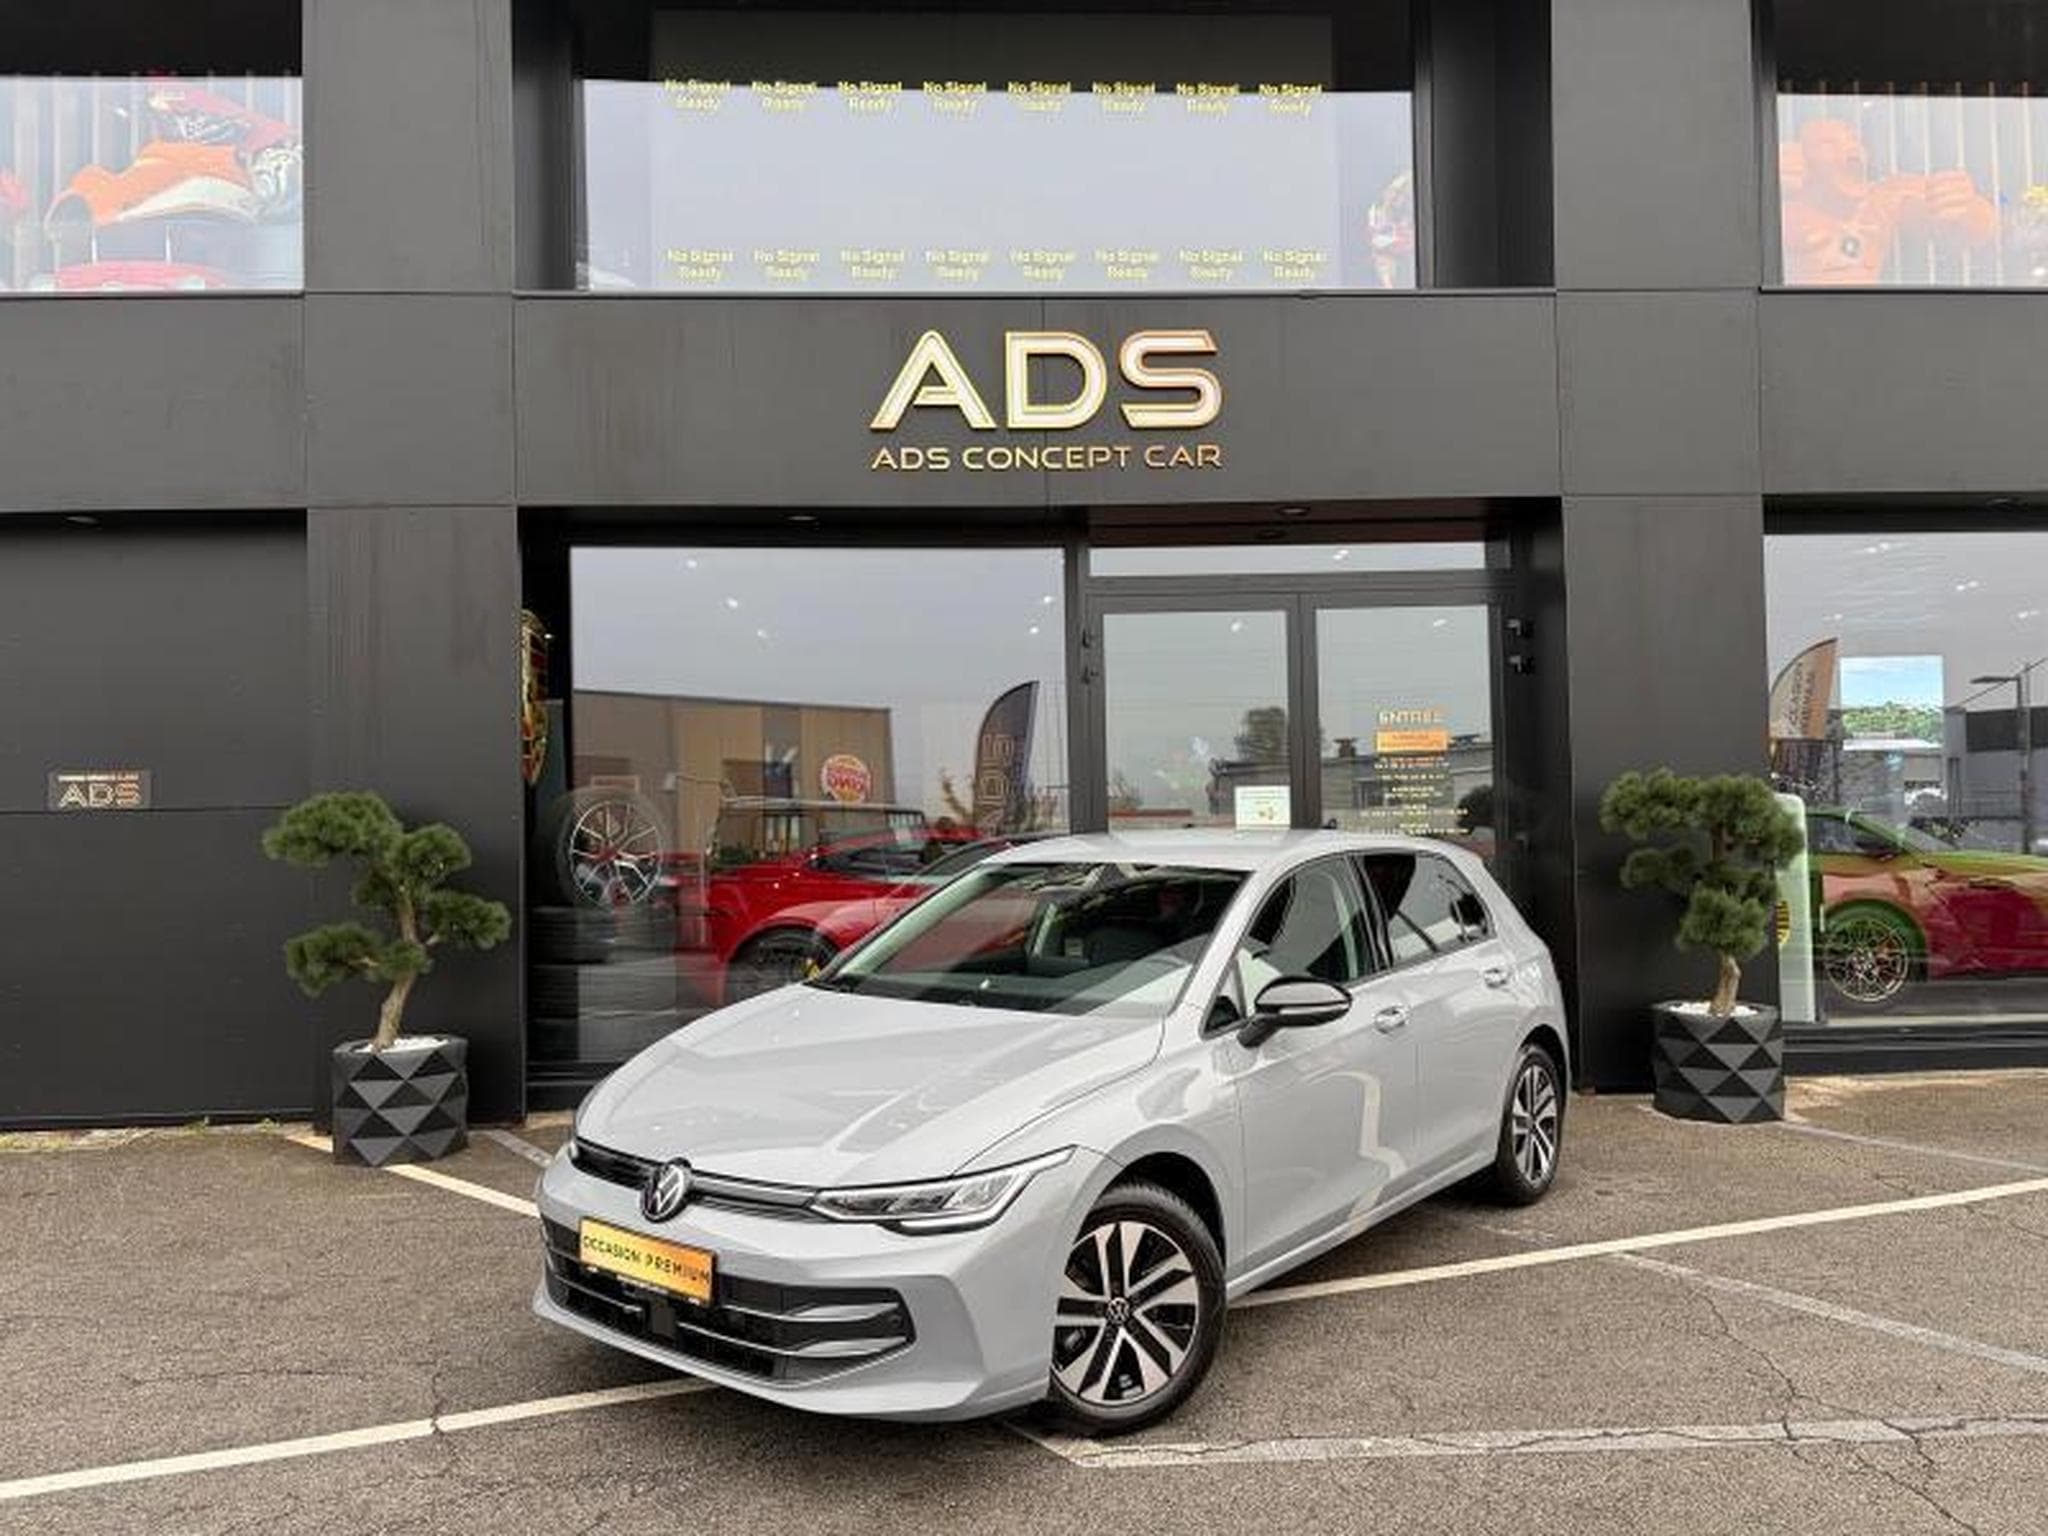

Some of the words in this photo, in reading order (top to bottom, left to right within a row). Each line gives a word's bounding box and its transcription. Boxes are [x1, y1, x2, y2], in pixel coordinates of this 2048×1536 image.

[869, 329, 1222, 430] ADS
[871, 447, 951, 470] ADS
[963, 445, 1129, 470] CONCEPT
[1144, 444, 1222, 468] CAR
[58, 783, 141, 808] ADS
[582, 1235, 641, 1264] OCCASION
